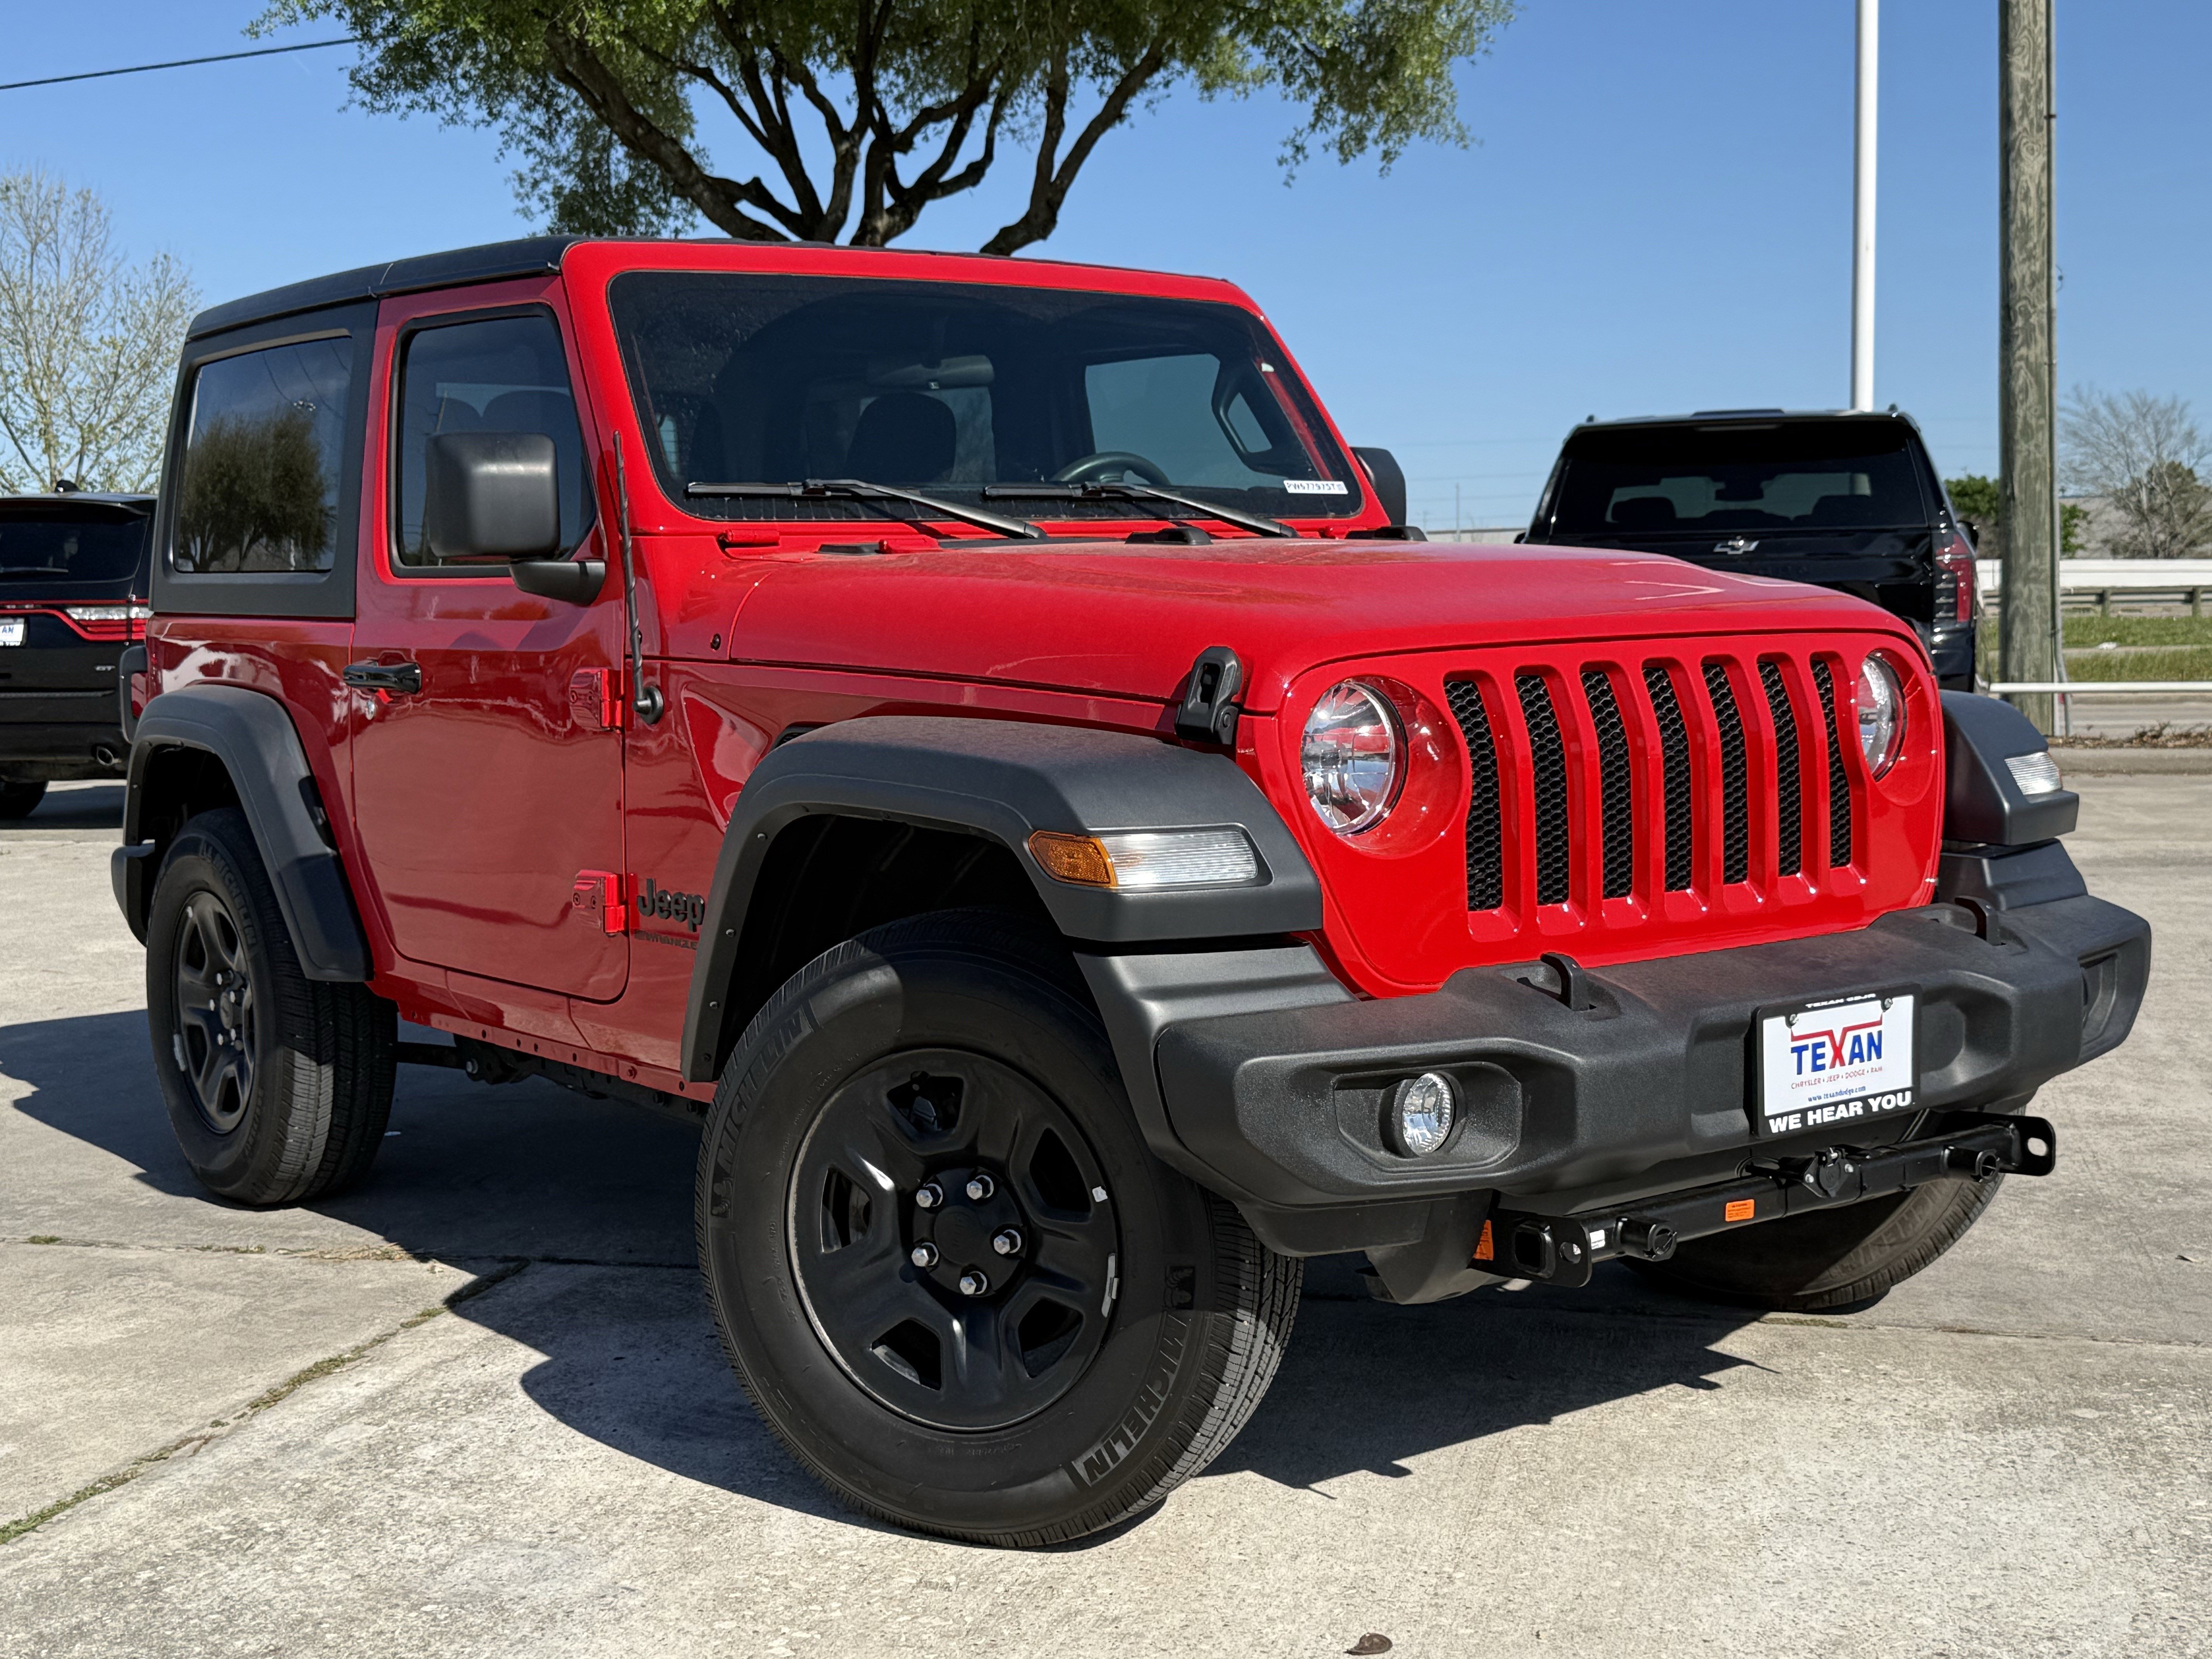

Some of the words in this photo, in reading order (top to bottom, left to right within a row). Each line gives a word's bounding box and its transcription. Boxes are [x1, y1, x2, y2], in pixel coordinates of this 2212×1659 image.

[637, 878, 705, 933] Jeep
[1790, 1027, 1882, 1075] TEXAN
[1845, 1069, 1865, 1080] DODGE
[716, 1009, 804, 1175] MICHELIN
[1769, 1113, 1802, 1134] WE
[1807, 1101, 1863, 1126] HEAR
[1868, 1091, 1912, 1113] YOU
[1082, 1314, 1187, 1483] MICHELIN
